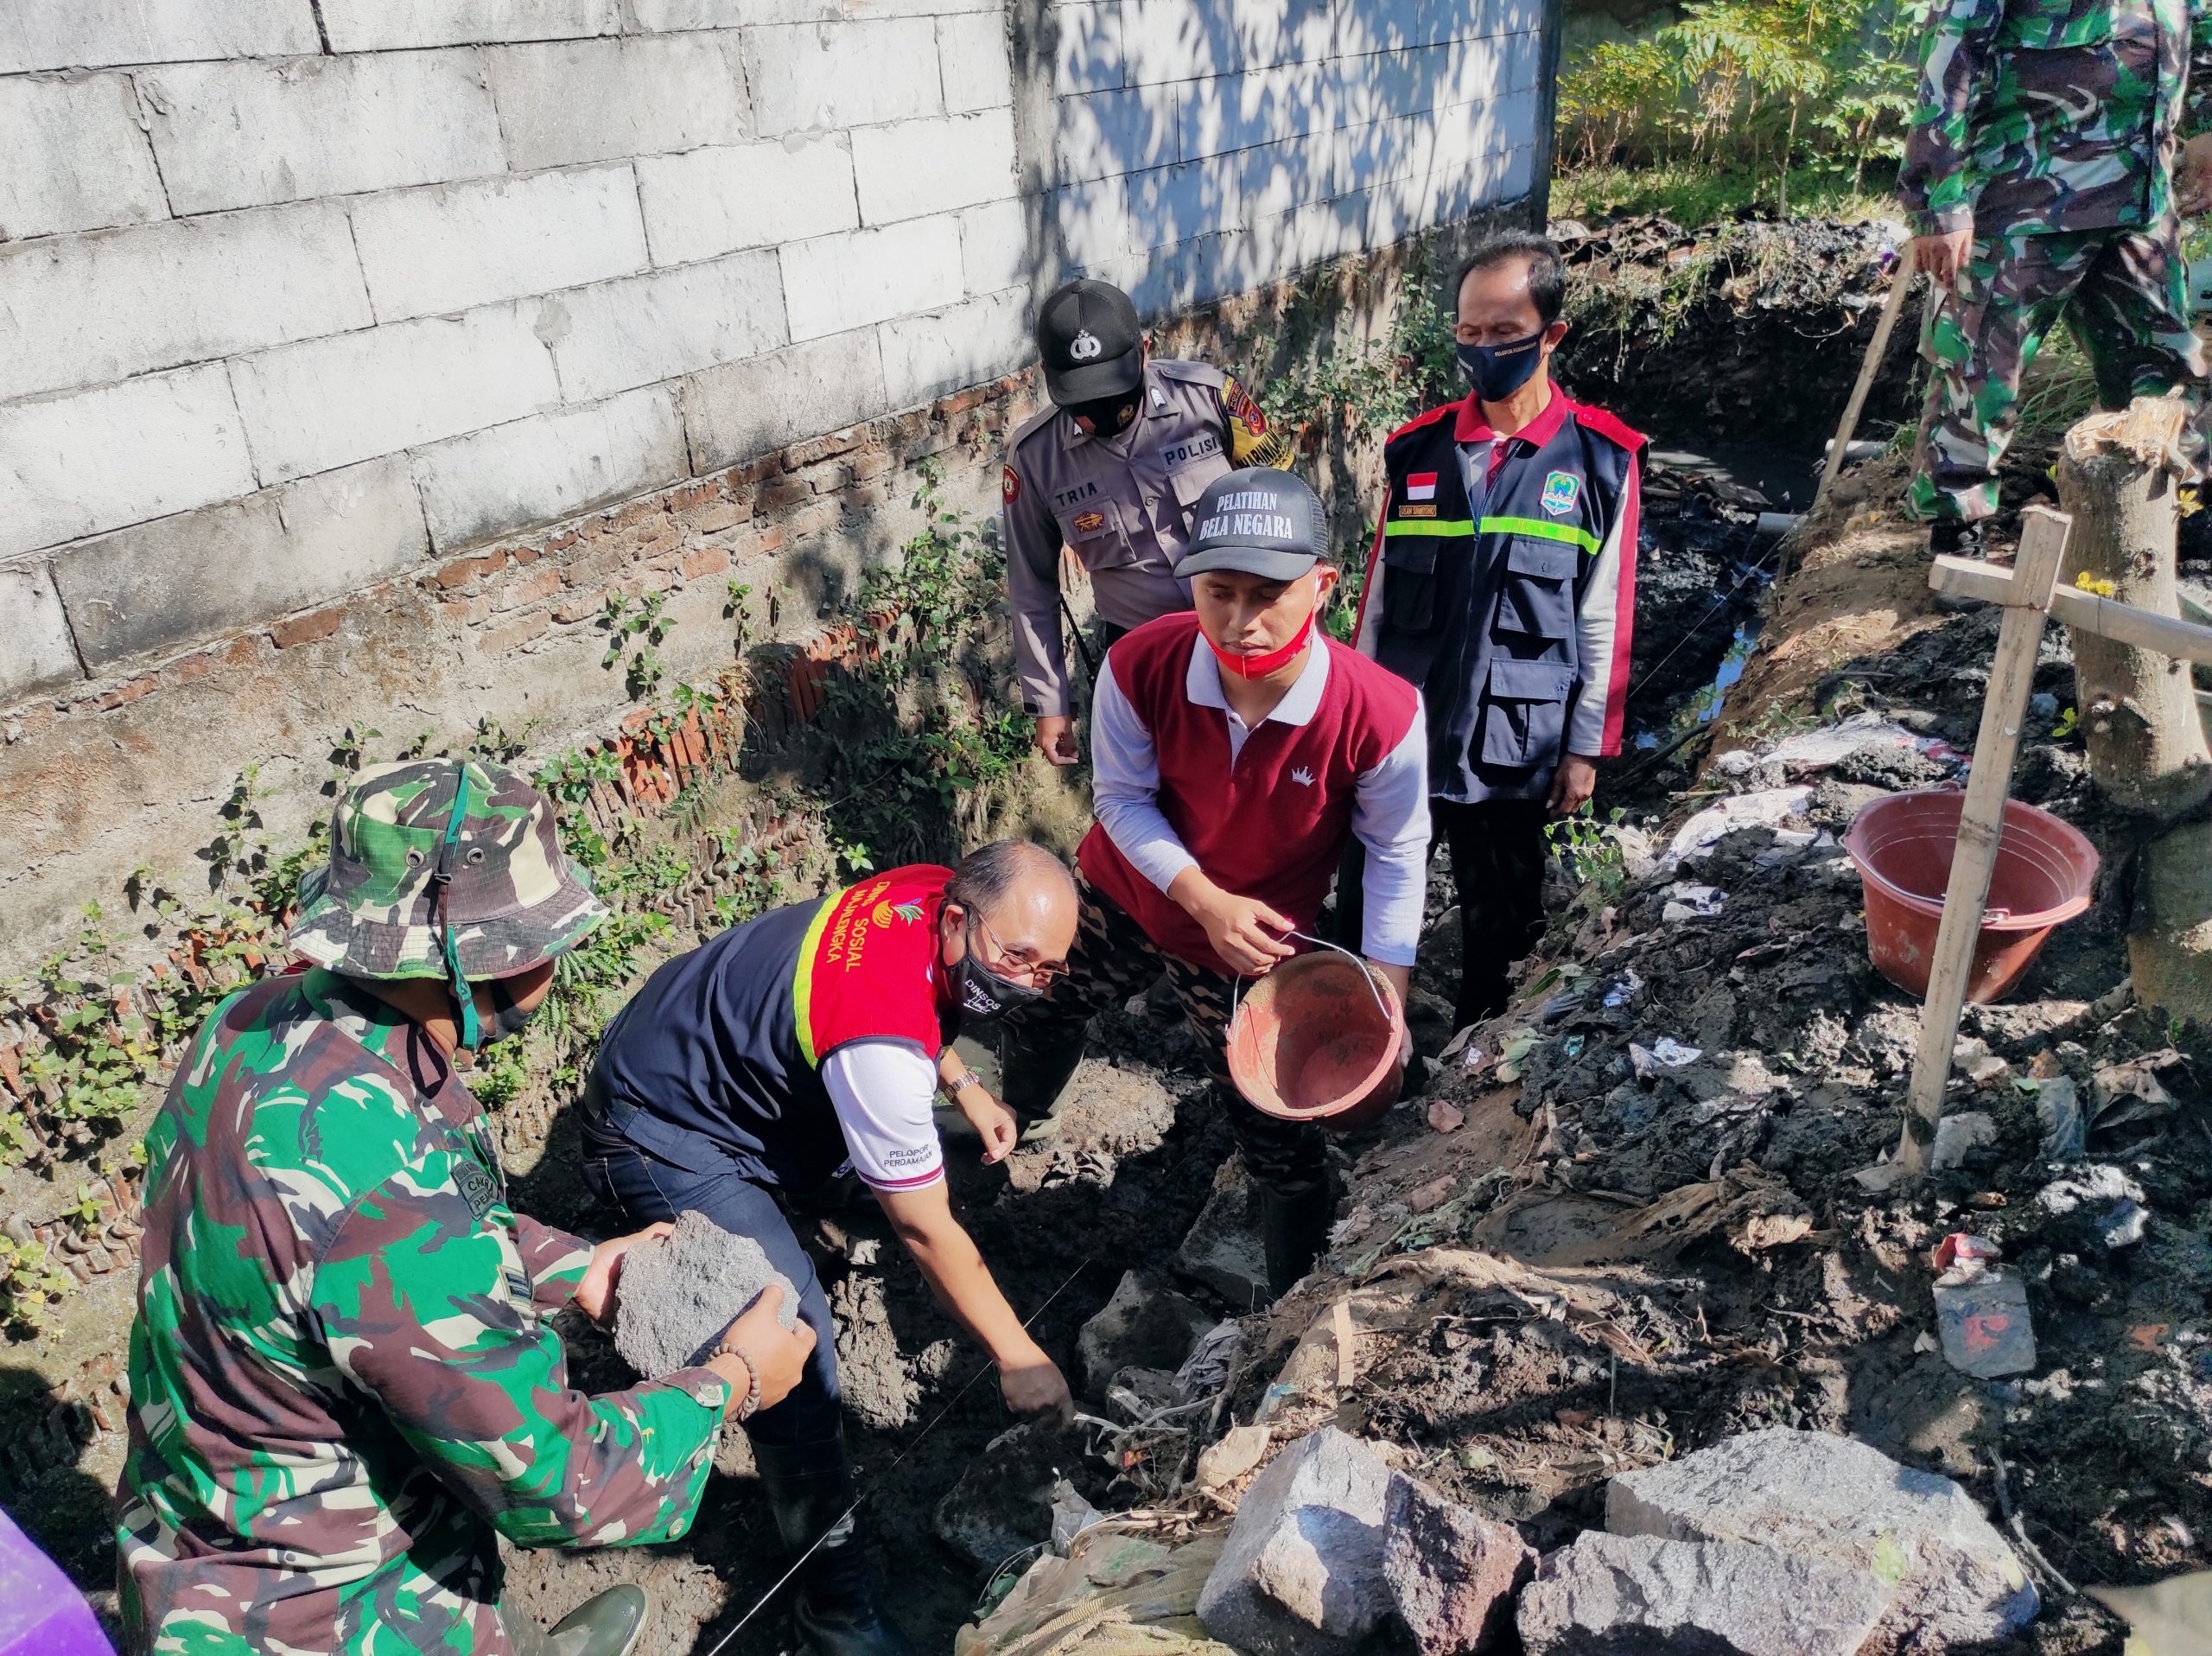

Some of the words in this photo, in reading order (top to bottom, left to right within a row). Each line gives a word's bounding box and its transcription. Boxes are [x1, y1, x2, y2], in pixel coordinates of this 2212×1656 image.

[1164, 436, 1218, 466] POLISI
[1055, 481, 1098, 506] TRIA
[1216, 491, 1278, 513] PELATIHAN
[1198, 513, 1229, 541] BELA
[1232, 513, 1294, 540] NEGARA
[826, 889, 868, 964] MAJALENGKA
[845, 918, 869, 972] SOSIAL
[965, 979, 1001, 1010] DINSOS
[884, 1150, 933, 1168] PERDAMAIAN
[889, 1143, 929, 1158] PELOPOR
